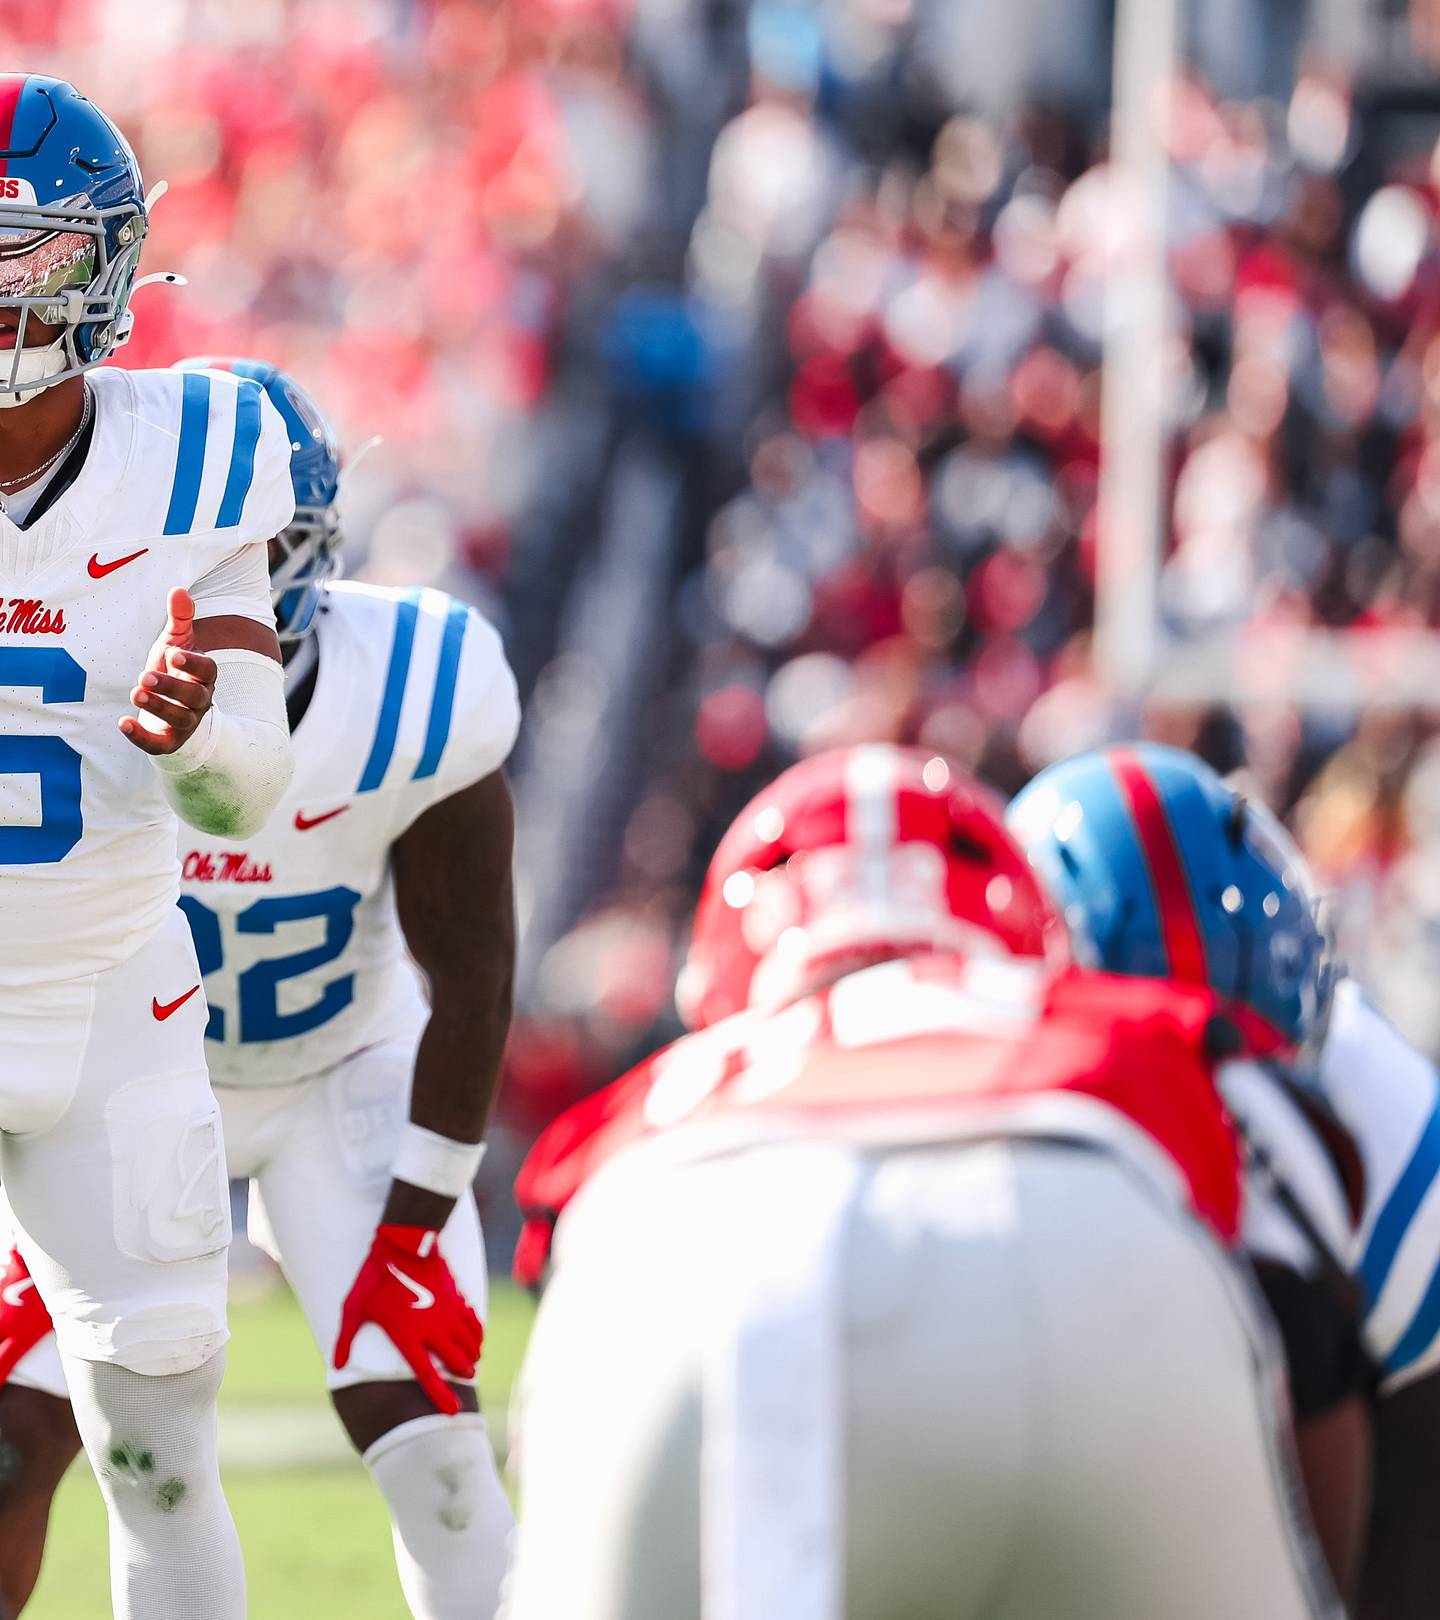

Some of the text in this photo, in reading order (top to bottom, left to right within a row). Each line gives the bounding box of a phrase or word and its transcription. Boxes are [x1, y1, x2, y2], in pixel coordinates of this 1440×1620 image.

[6, 598, 67, 635] Miss
[181, 850, 274, 882] Ole Miss
